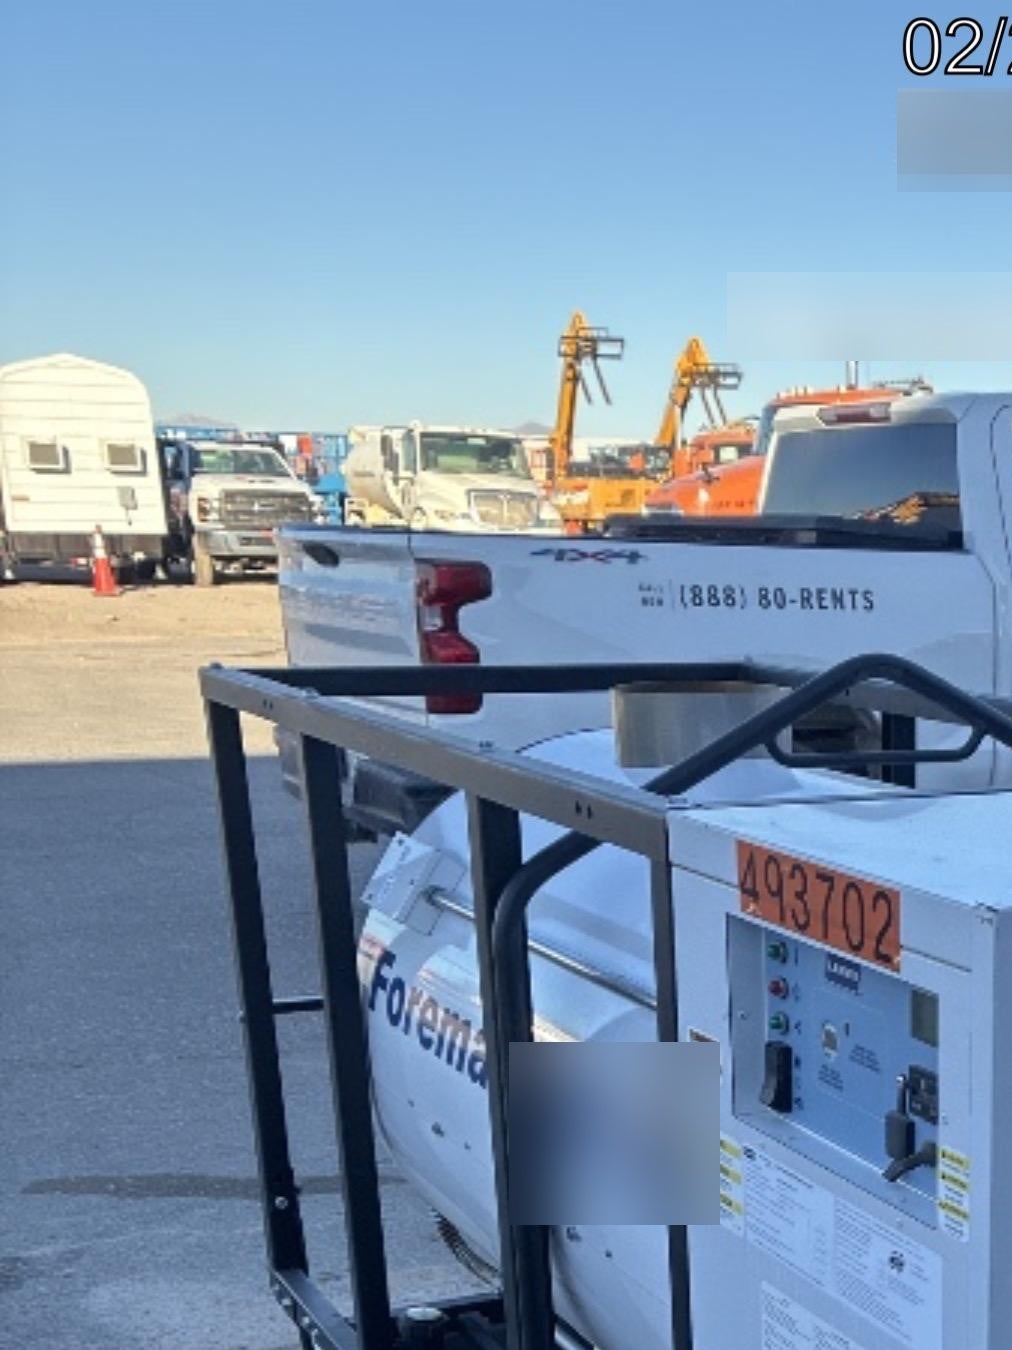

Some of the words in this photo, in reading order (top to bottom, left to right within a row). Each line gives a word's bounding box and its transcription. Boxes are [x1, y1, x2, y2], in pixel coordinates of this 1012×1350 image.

[680, 583, 747, 610] (888)
[758, 586, 875, 612] 80-RENTS
[739, 850, 894, 964] 493702
[368, 948, 489, 1089] Forema
